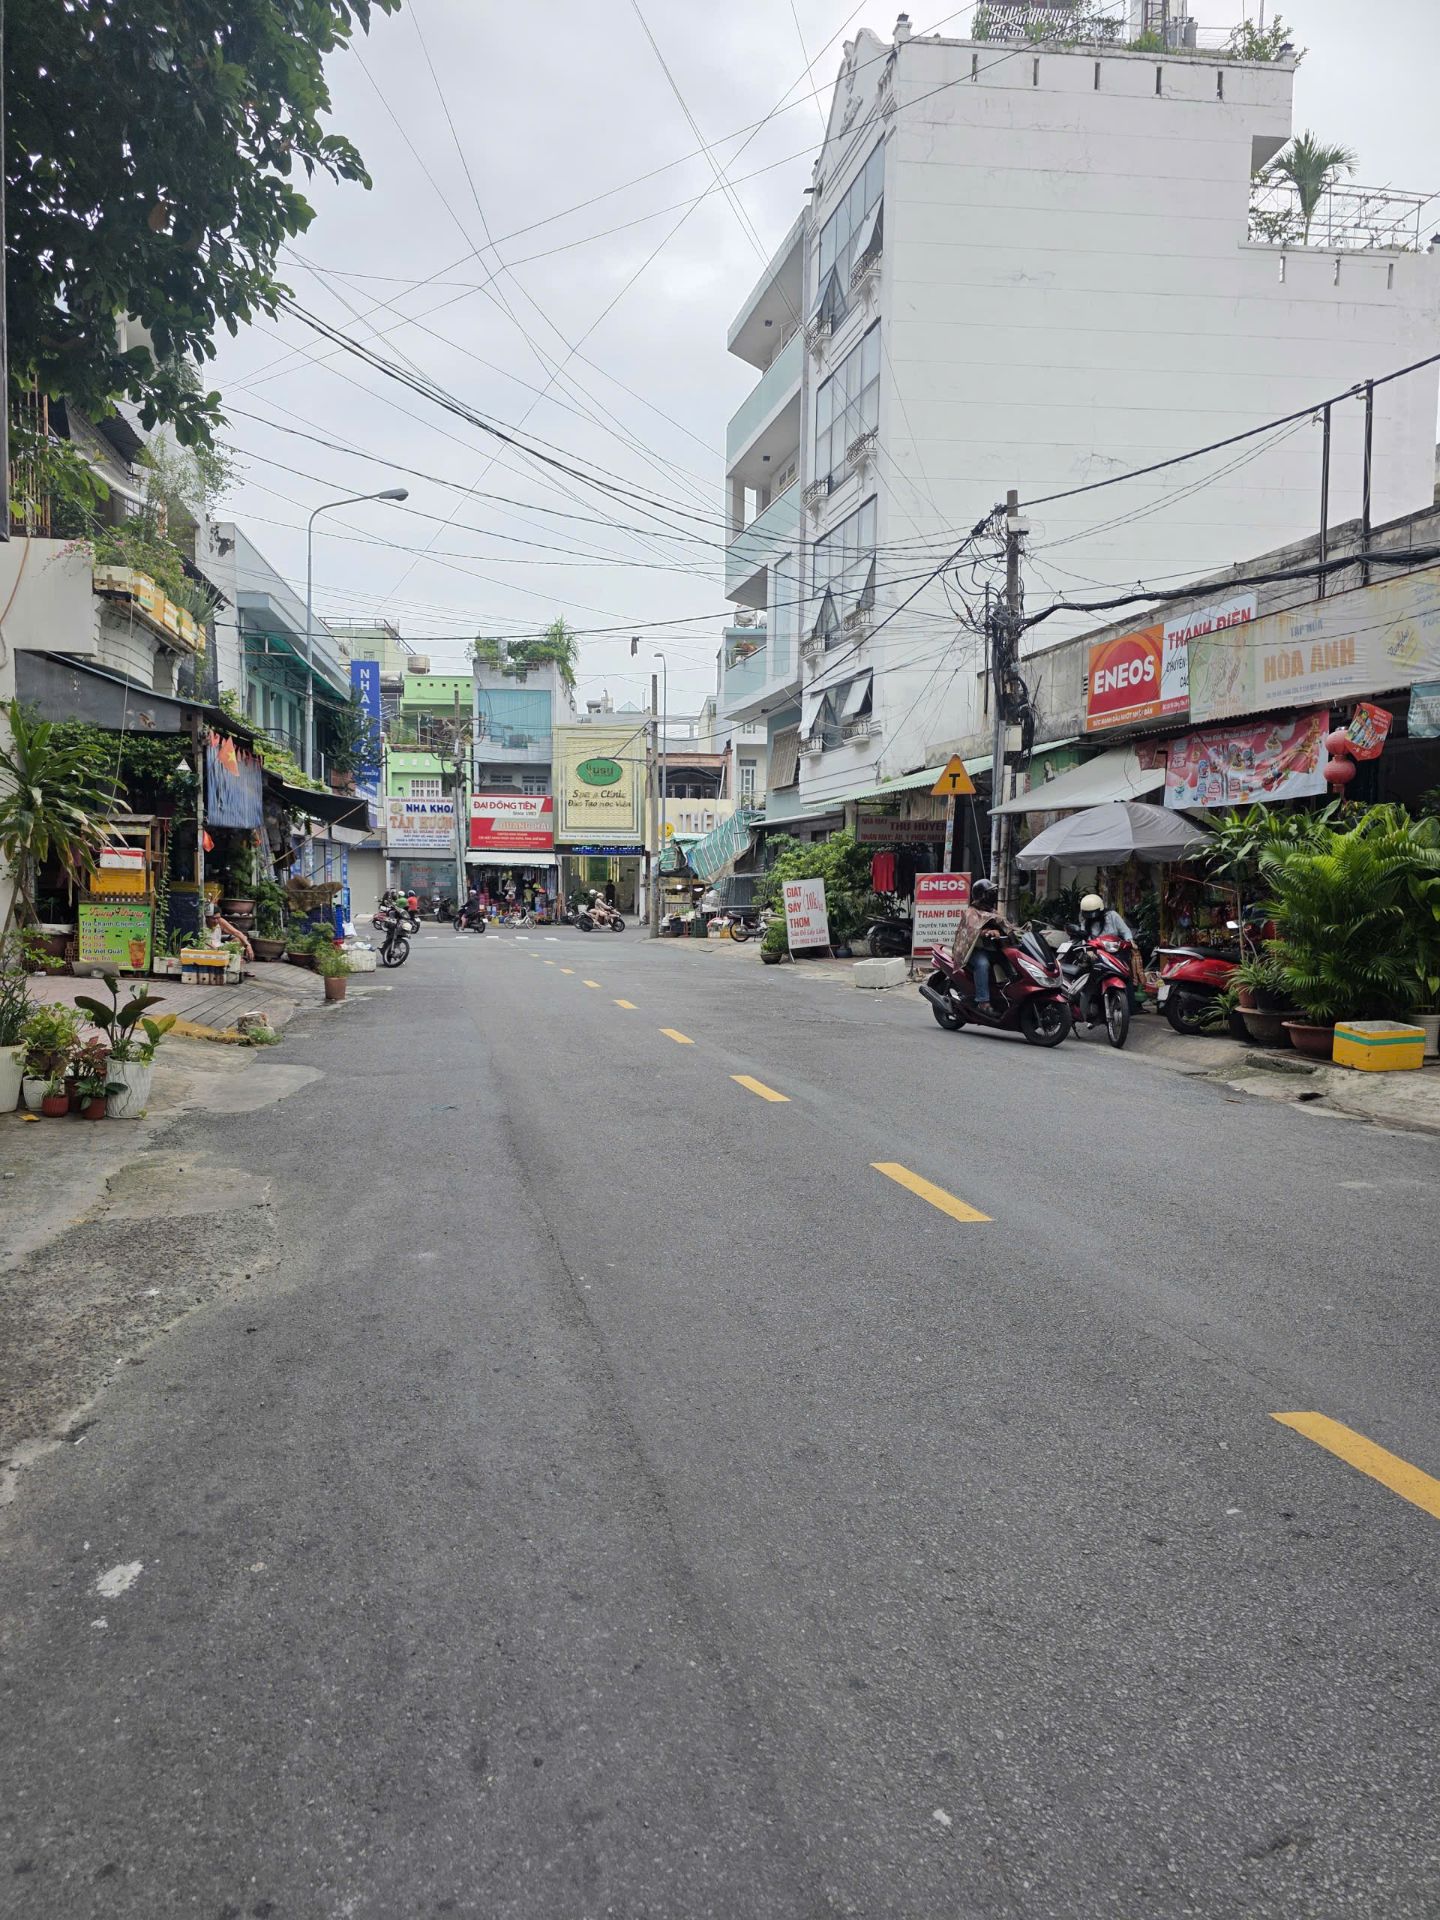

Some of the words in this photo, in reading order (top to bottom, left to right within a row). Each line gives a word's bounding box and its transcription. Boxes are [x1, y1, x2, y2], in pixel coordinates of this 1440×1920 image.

[1094, 655, 1155, 695] ENEOS
[360, 668, 370, 704] NHÀ
[406, 804, 427, 813] NHA
[474, 801, 488, 811] ĐẠI
[920, 880, 966, 891] ENEOS
[917, 910, 945, 918] THANH
